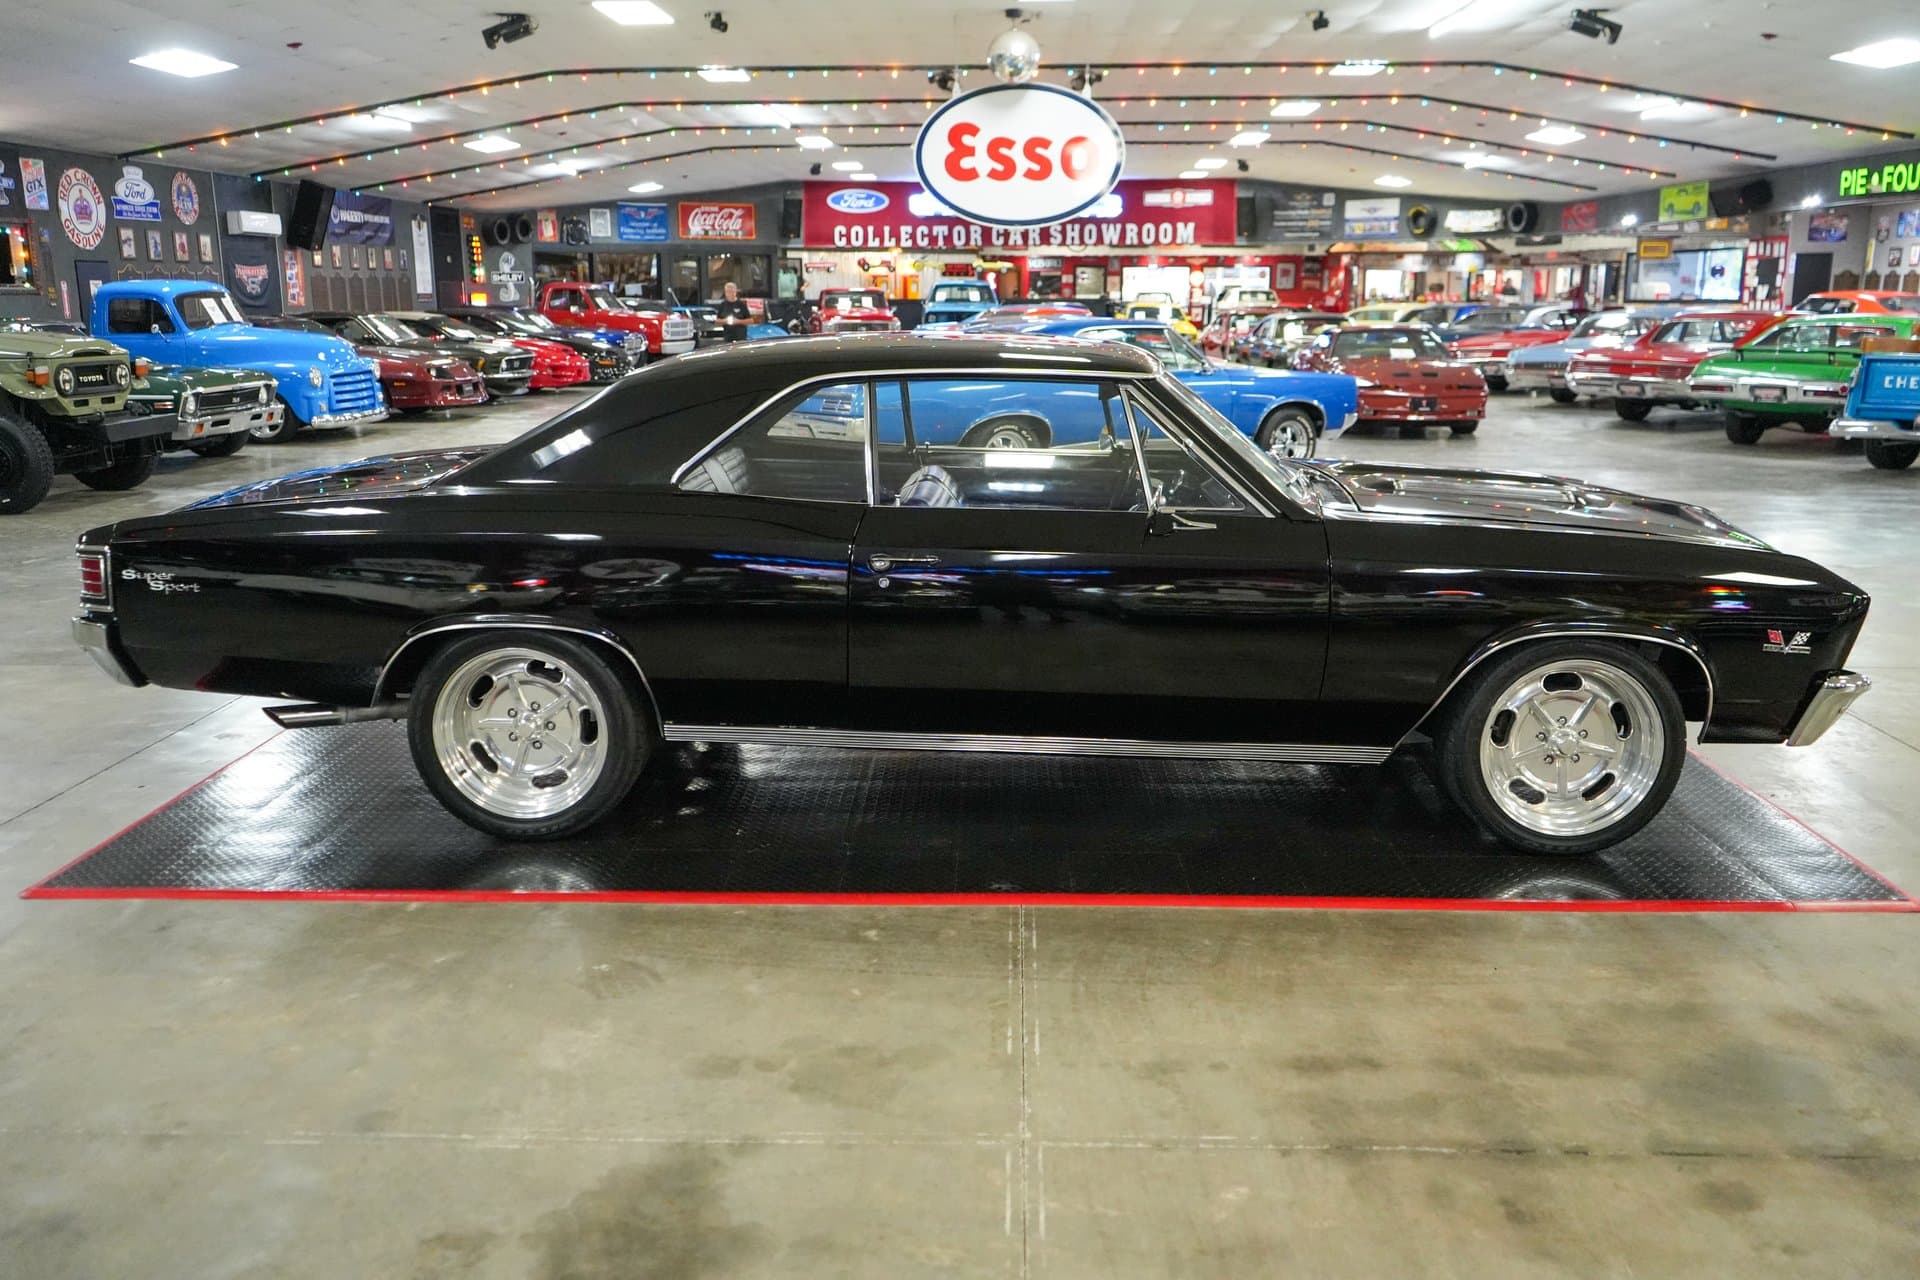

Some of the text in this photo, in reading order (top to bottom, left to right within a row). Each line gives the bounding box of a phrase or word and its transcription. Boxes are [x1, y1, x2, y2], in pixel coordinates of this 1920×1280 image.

[944, 121, 1099, 182] Esso
[26, 176, 44, 193] GTX
[59, 174, 73, 202] RED
[73, 169, 103, 205] CROWN
[124, 182, 147, 200] Ford
[1840, 168, 1868, 196] PIE
[840, 192, 875, 208] Ford
[688, 207, 744, 231] Coca-Cola
[63, 218, 105, 248] GASOLINE
[833, 222, 1196, 248] COLLECTOR CAR SHOWROOM
[78, 374, 104, 382] TOYOTA
[1883, 375, 1920, 389] CHE
[121, 568, 177, 584] Super
[149, 580, 201, 595] Sport
